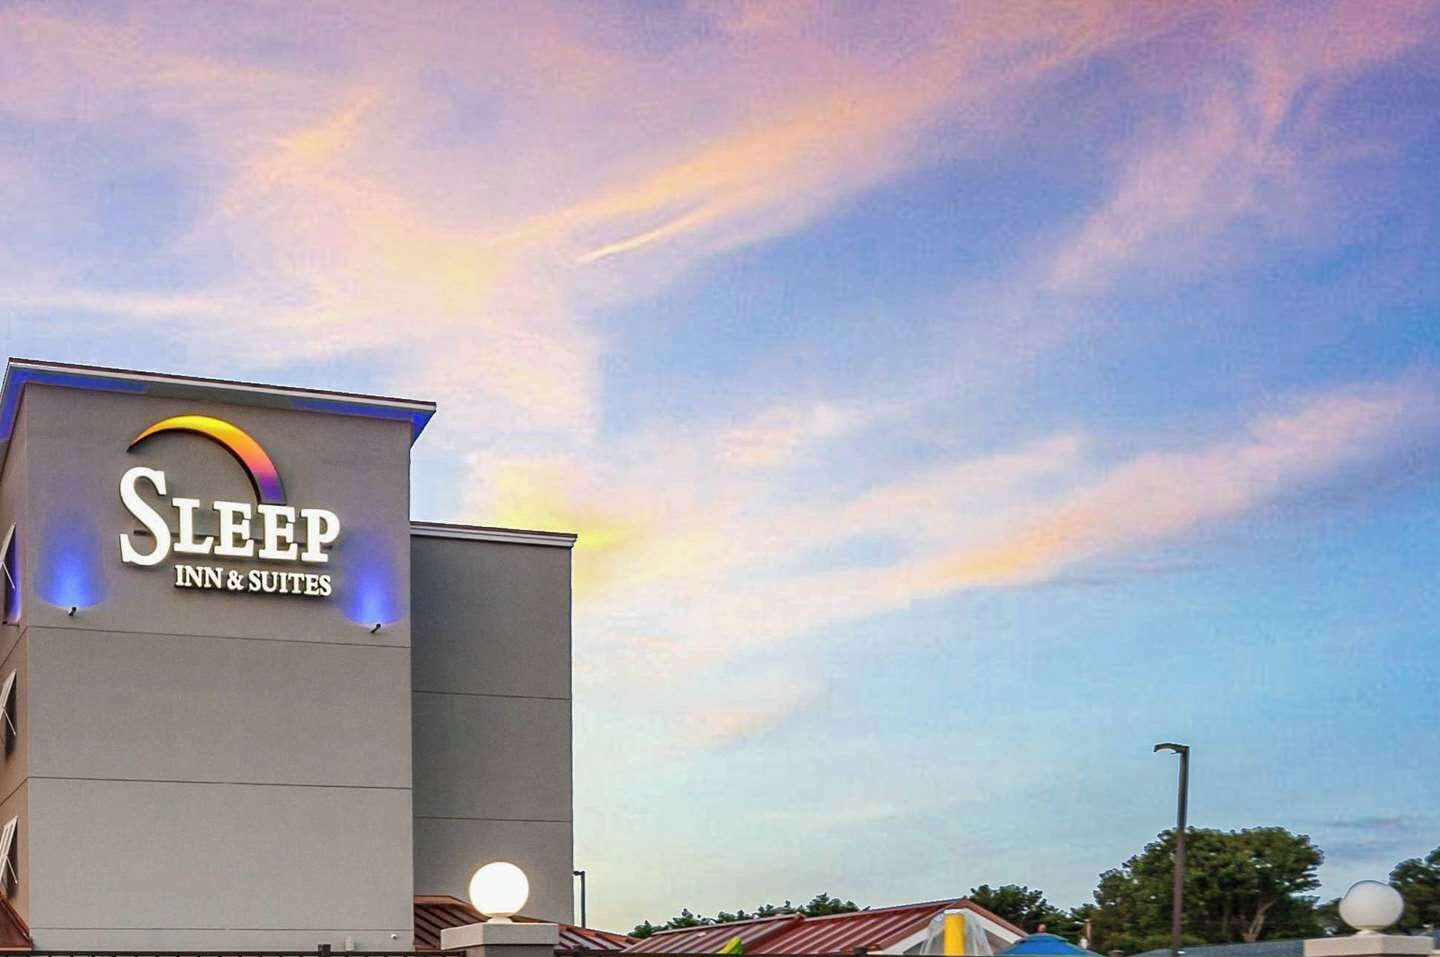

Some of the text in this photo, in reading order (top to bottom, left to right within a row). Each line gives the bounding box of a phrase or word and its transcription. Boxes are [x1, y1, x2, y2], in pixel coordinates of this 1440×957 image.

[119, 467, 340, 566] SLEEP
[175, 564, 332, 597] INN & SUITES
